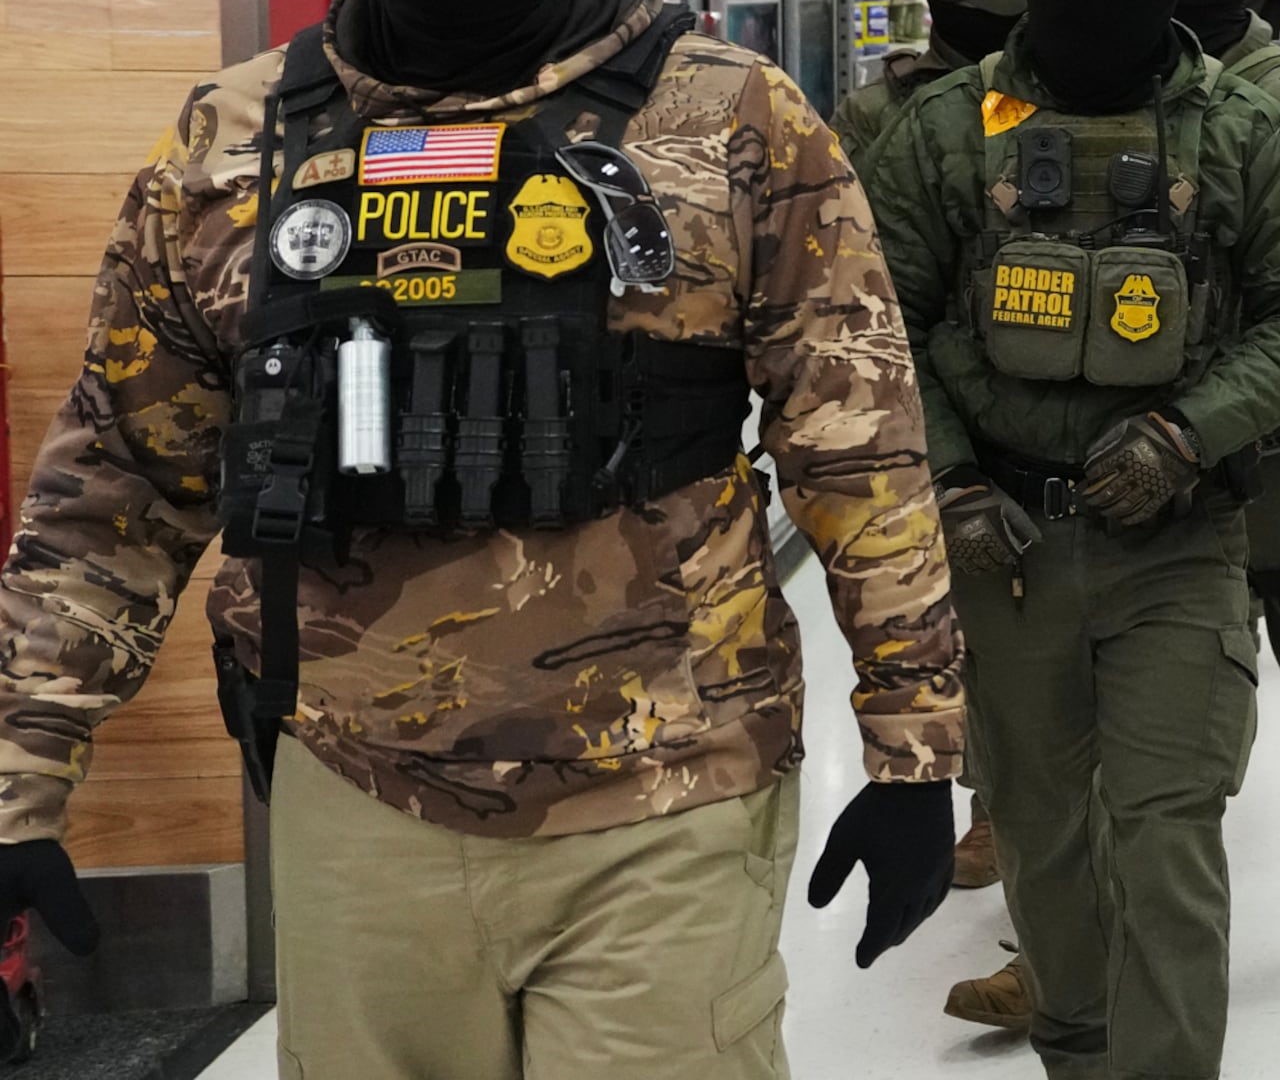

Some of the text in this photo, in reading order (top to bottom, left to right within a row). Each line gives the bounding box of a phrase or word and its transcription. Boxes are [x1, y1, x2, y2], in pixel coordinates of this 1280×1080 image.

[357, 190, 490, 242] POLICE
[396, 249, 441, 265] GTAC
[360, 275, 458, 301] 2005
[995, 264, 1076, 294] BORDER
[993, 287, 1073, 316] PATROL
[992, 309, 1072, 329] FEDERAL AGENT
